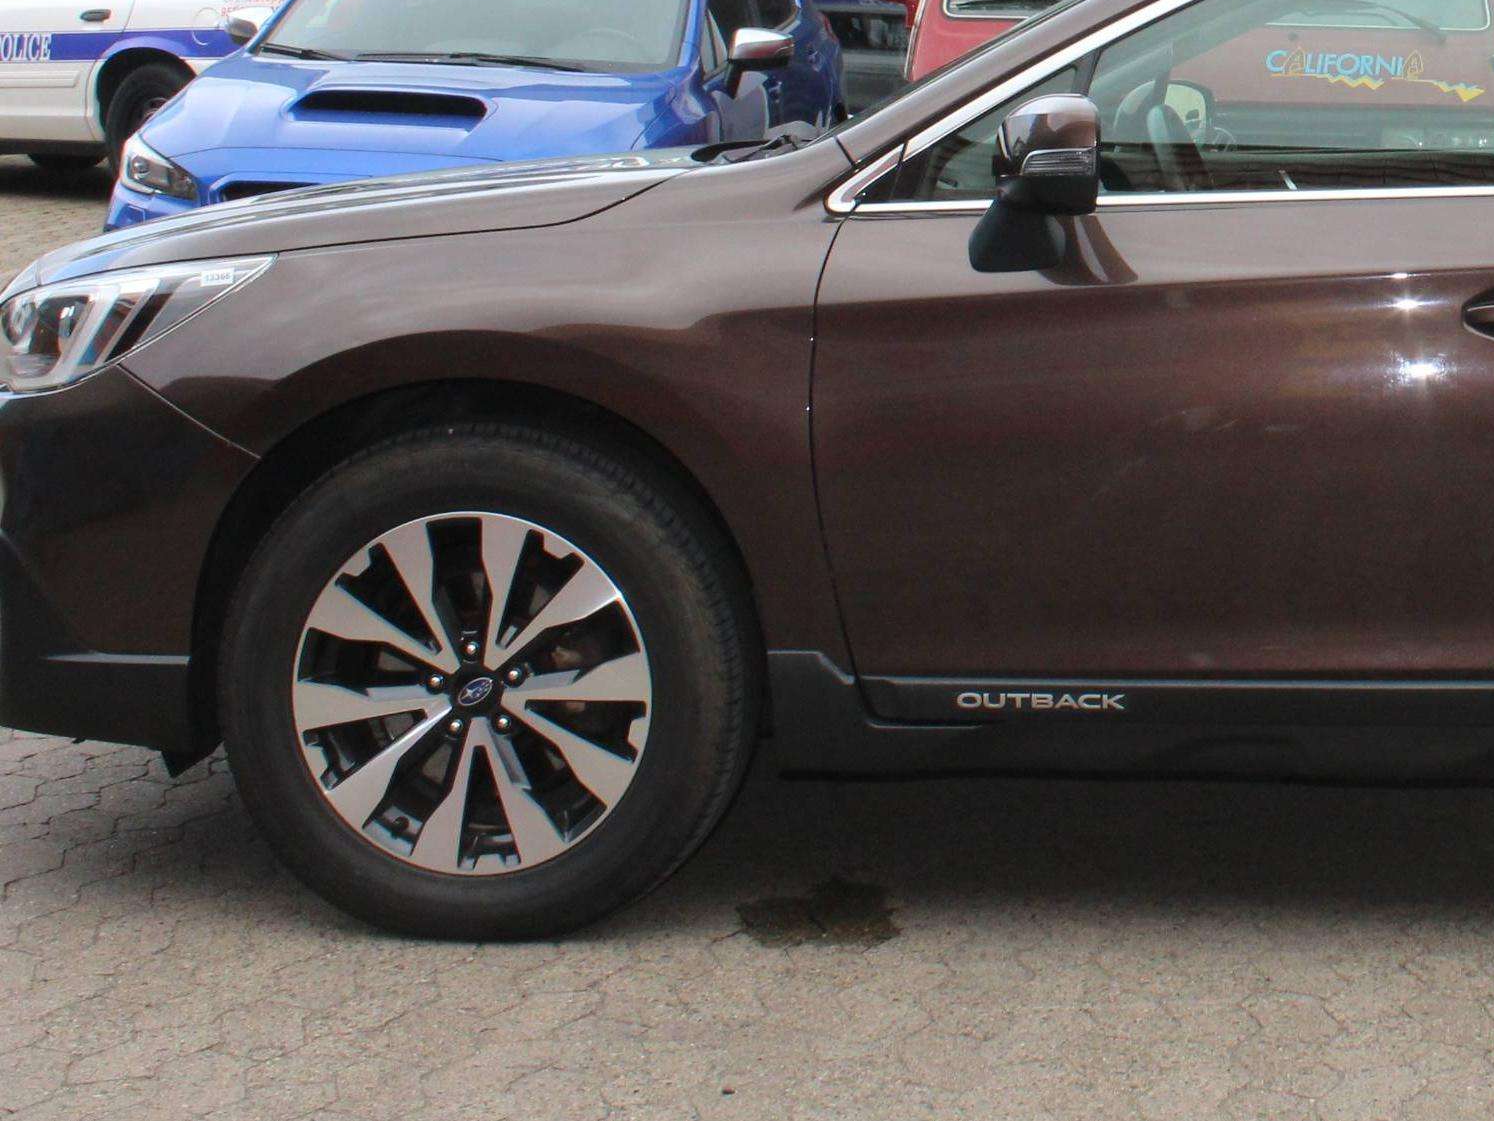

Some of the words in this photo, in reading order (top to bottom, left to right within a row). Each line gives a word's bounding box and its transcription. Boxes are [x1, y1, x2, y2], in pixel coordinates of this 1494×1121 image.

[0, 33, 51, 61] OLICE
[1265, 46, 1425, 80] CALIFORNIA
[956, 691, 1126, 710] OUTBACK
